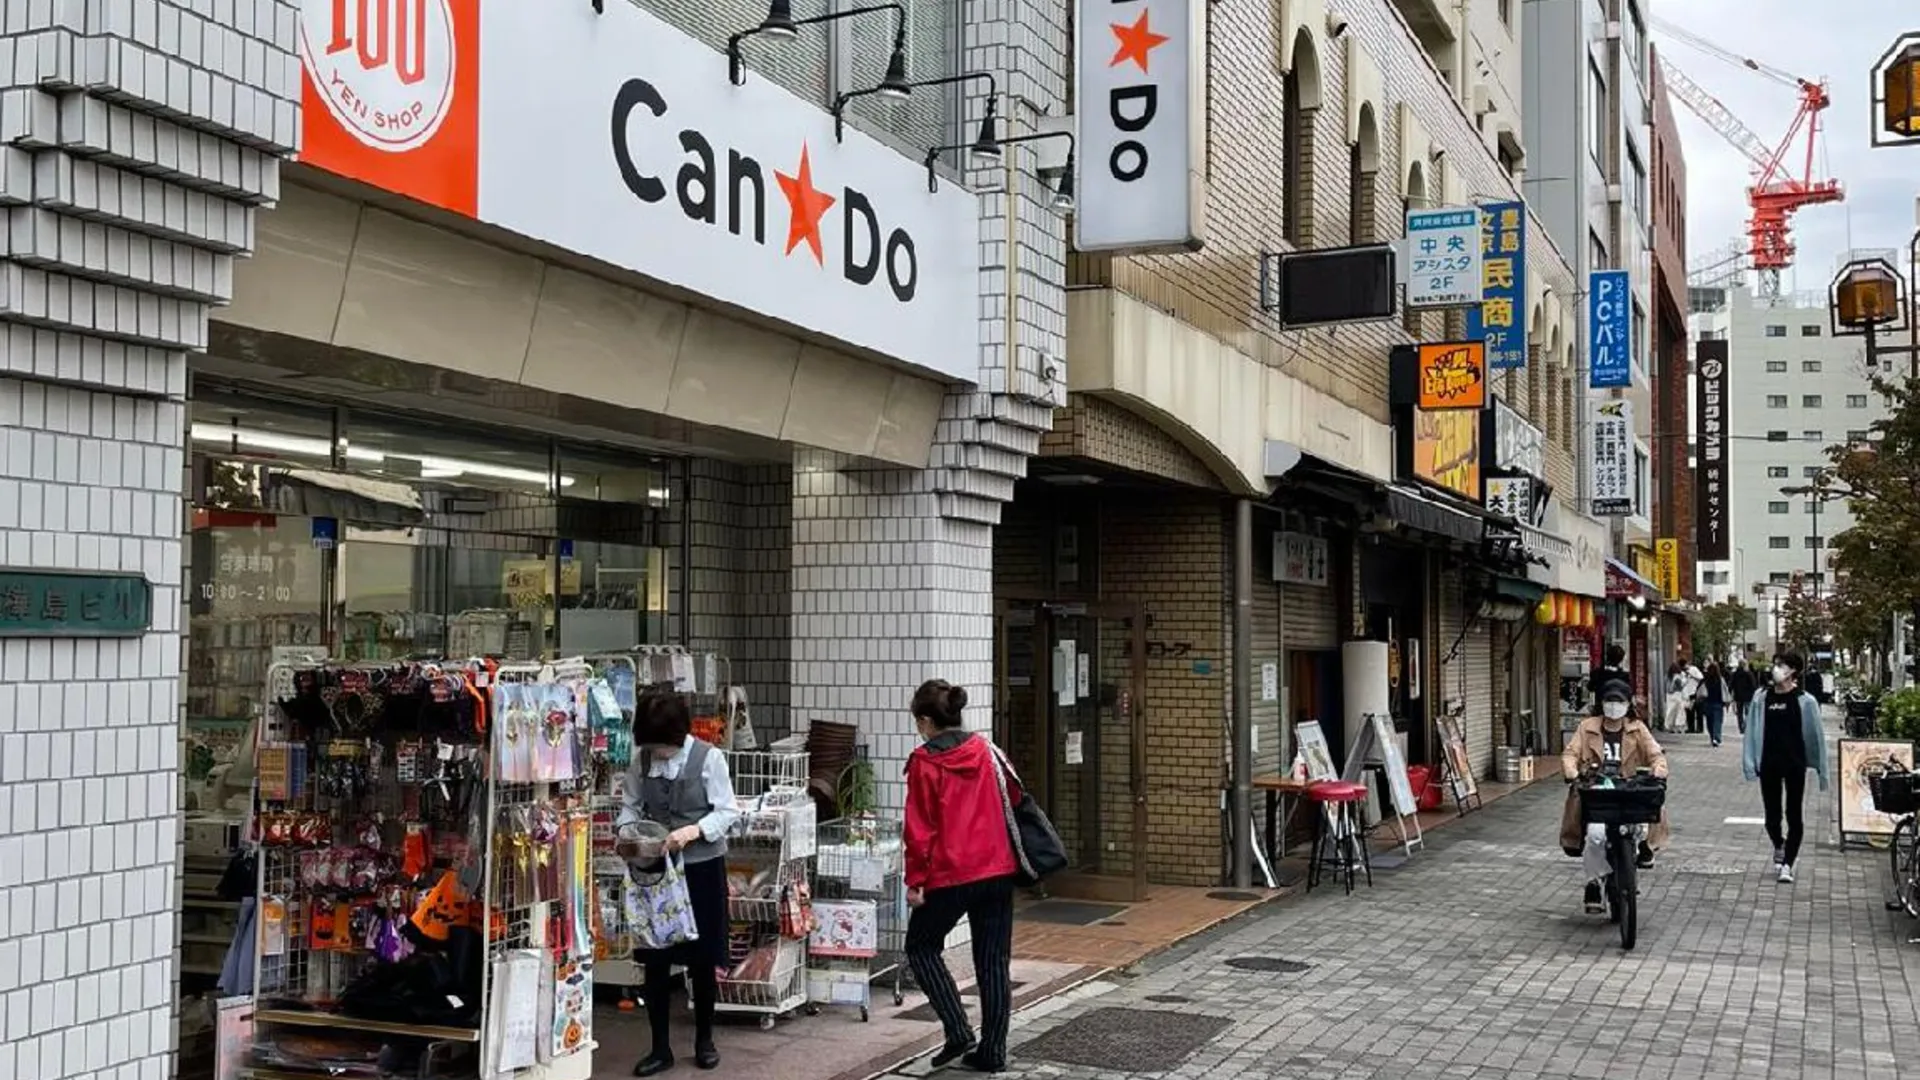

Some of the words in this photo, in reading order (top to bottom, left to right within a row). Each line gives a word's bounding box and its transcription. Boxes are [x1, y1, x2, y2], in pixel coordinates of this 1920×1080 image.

[326, 0, 426, 85] 100
[331, 68, 368, 118] YEN
[374, 101, 423, 130] SHOP
[611, 78, 765, 245] Can
[844, 186, 917, 302] Do
[1413, 256, 1471, 273] アシスタ
[1420, 235, 1465, 254] 中央
[1430, 275, 1454, 290] 2F
[1483, 257, 1514, 329] 民商
[1704, 380, 1721, 461] ビックカメラ
[1707, 468, 1720, 544] 研修センター
